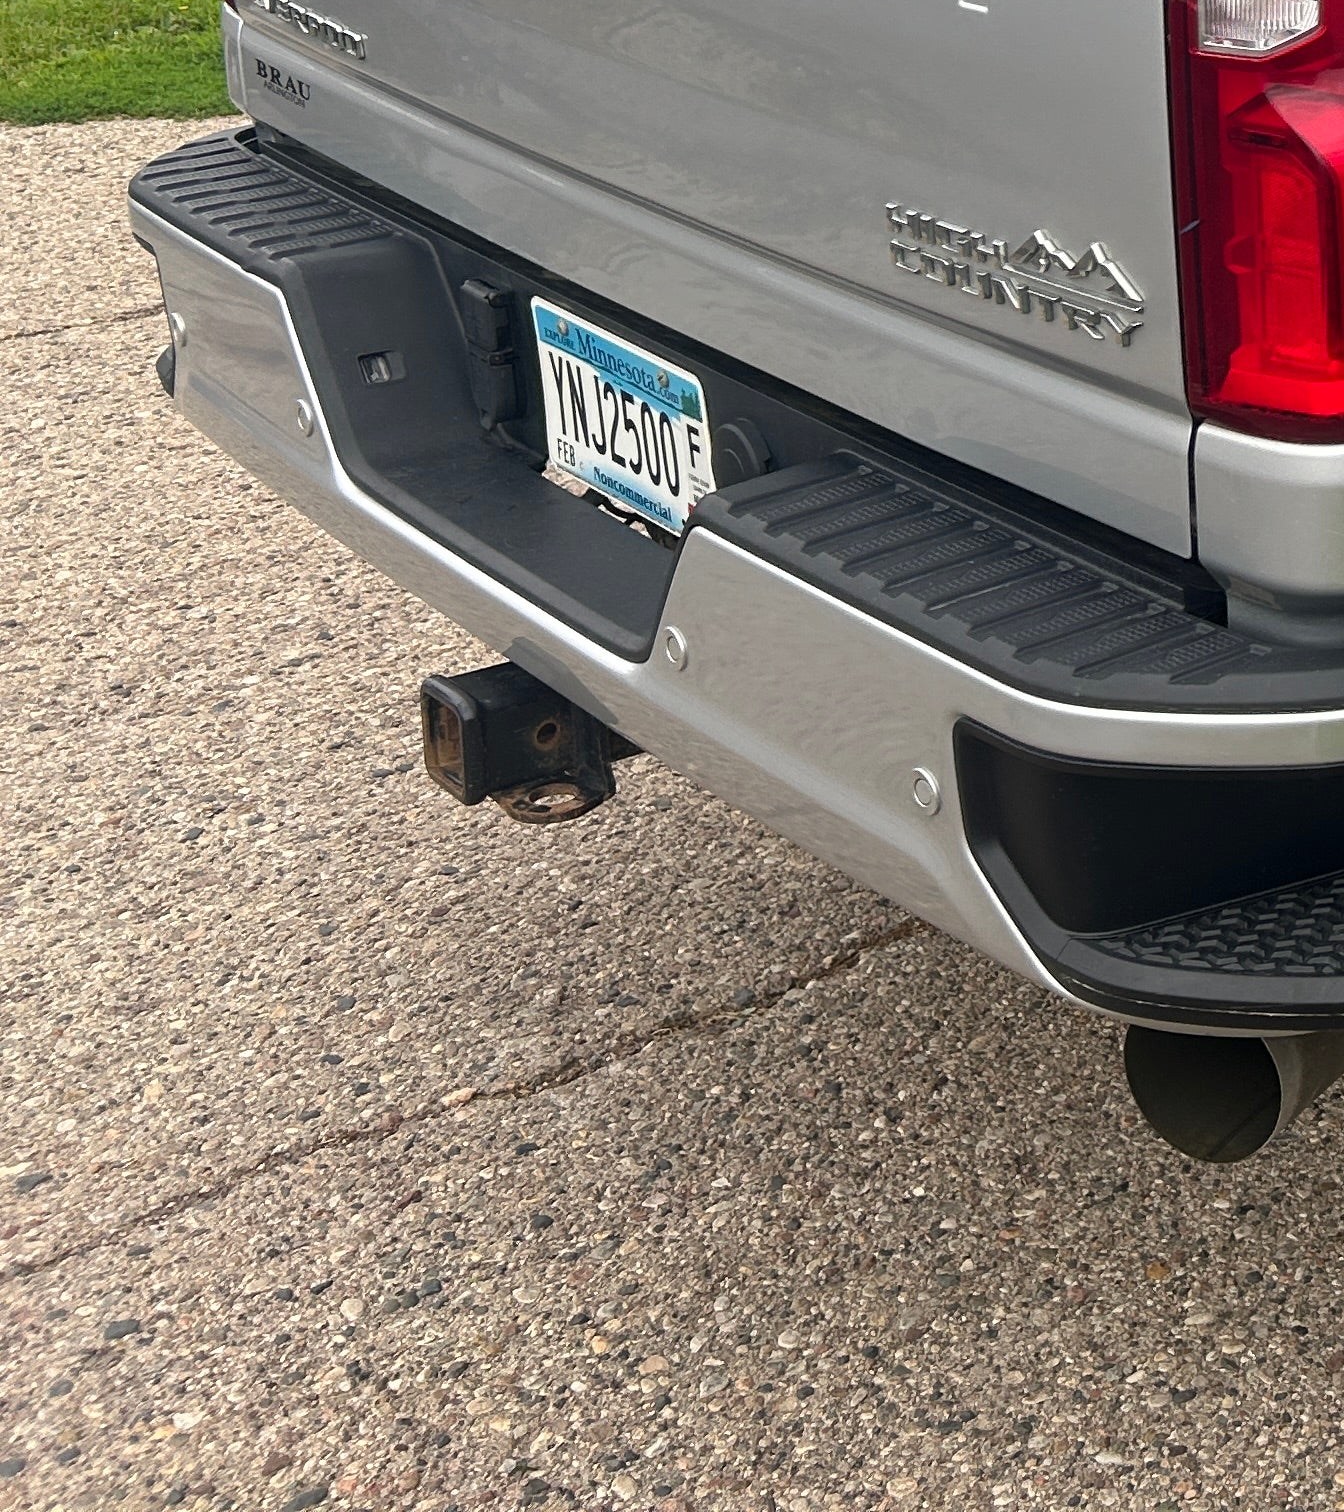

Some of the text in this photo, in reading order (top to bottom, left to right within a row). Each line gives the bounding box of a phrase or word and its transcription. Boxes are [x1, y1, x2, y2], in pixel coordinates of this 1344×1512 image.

[255, 58, 311, 101] BRAU
[884, 201, 1009, 268] HIGH
[889, 238, 1144, 348] COUNTRY
[548, 350, 681, 498] YNJ2500
[557, 438, 576, 467] FEB
[593, 466, 673, 523] Noncommercial
